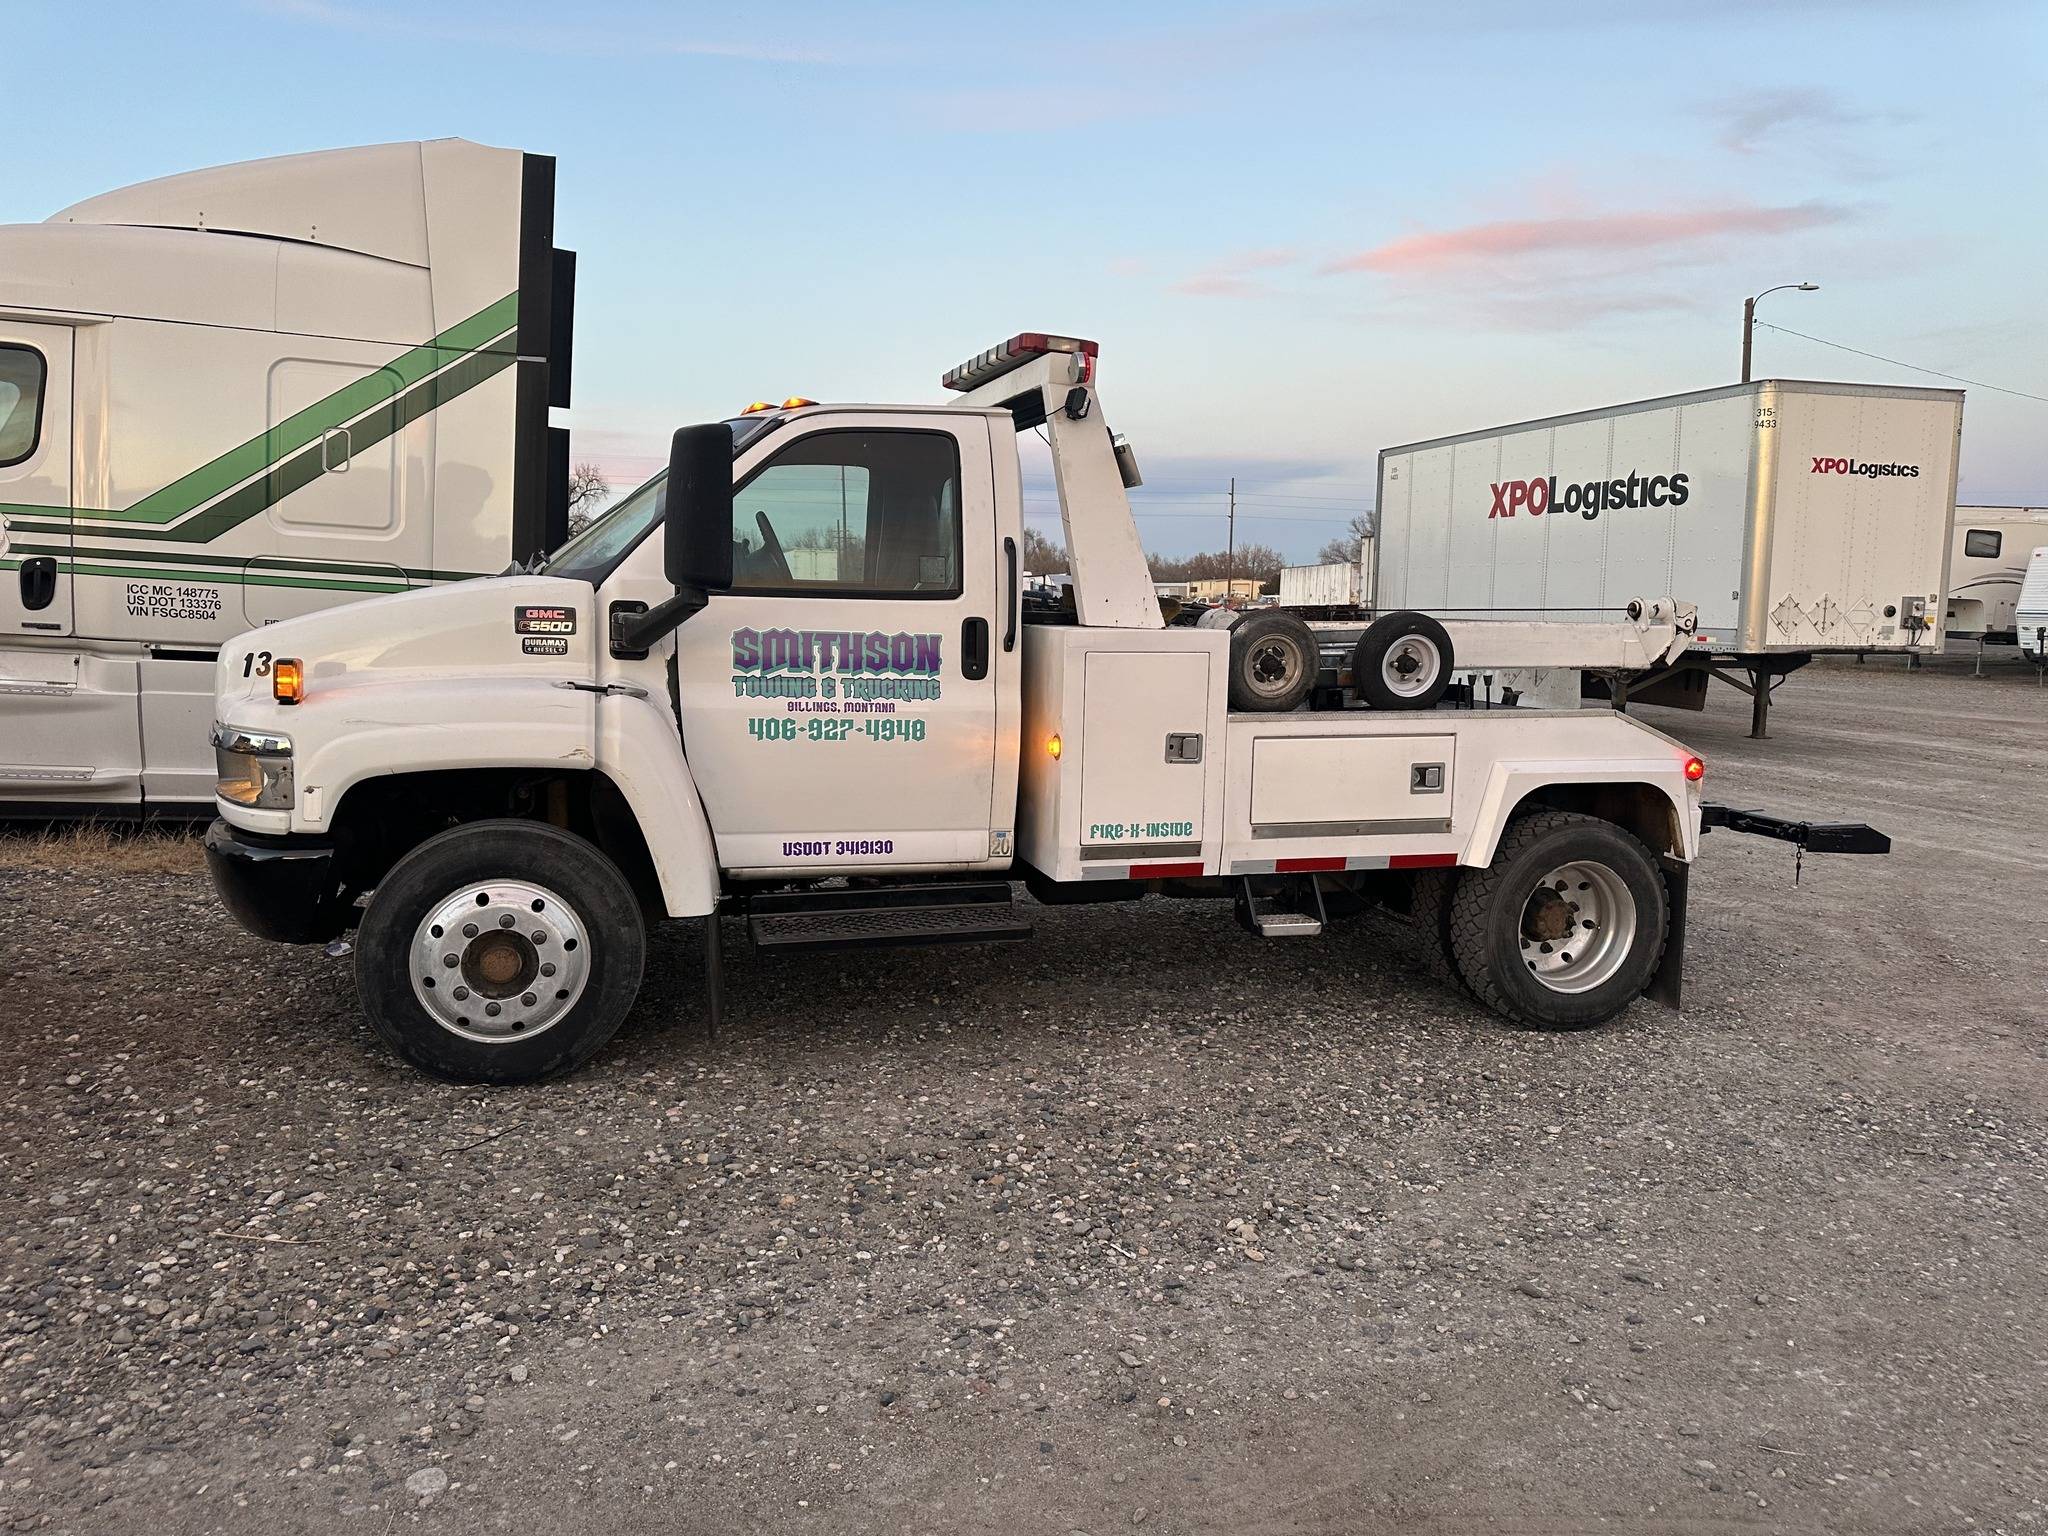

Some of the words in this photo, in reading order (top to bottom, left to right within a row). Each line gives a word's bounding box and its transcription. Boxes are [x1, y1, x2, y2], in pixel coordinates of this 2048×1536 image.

[1756, 407, 1776, 417] 315-
[1754, 419, 1777, 428] 9433
[127, 584, 149, 595] ICC
[152, 585, 173, 596] MC
[176, 587, 219, 599] 148775
[127, 595, 146, 606] US
[149, 596, 177, 607] DOT
[180, 598, 222, 610] 133376
[127, 606, 149, 617] VIN
[152, 608, 217, 621] FSGC8504
[525, 609, 565, 619] GMC
[518, 620, 573, 632] C5500
[524, 639, 566, 647] DURAMAX
[731, 627, 944, 677] SMITHSON
[243, 651, 272, 678] 13
[732, 675, 818, 699] TOWING
[840, 677, 942, 702] TRUCKING
[787, 701, 841, 714] BILLINGS,
[843, 702, 896, 714] MONTANA
[748, 717, 927, 742] 406-927-4948
[782, 841, 832, 857] USDOT
[836, 839, 894, 856] 3419130
